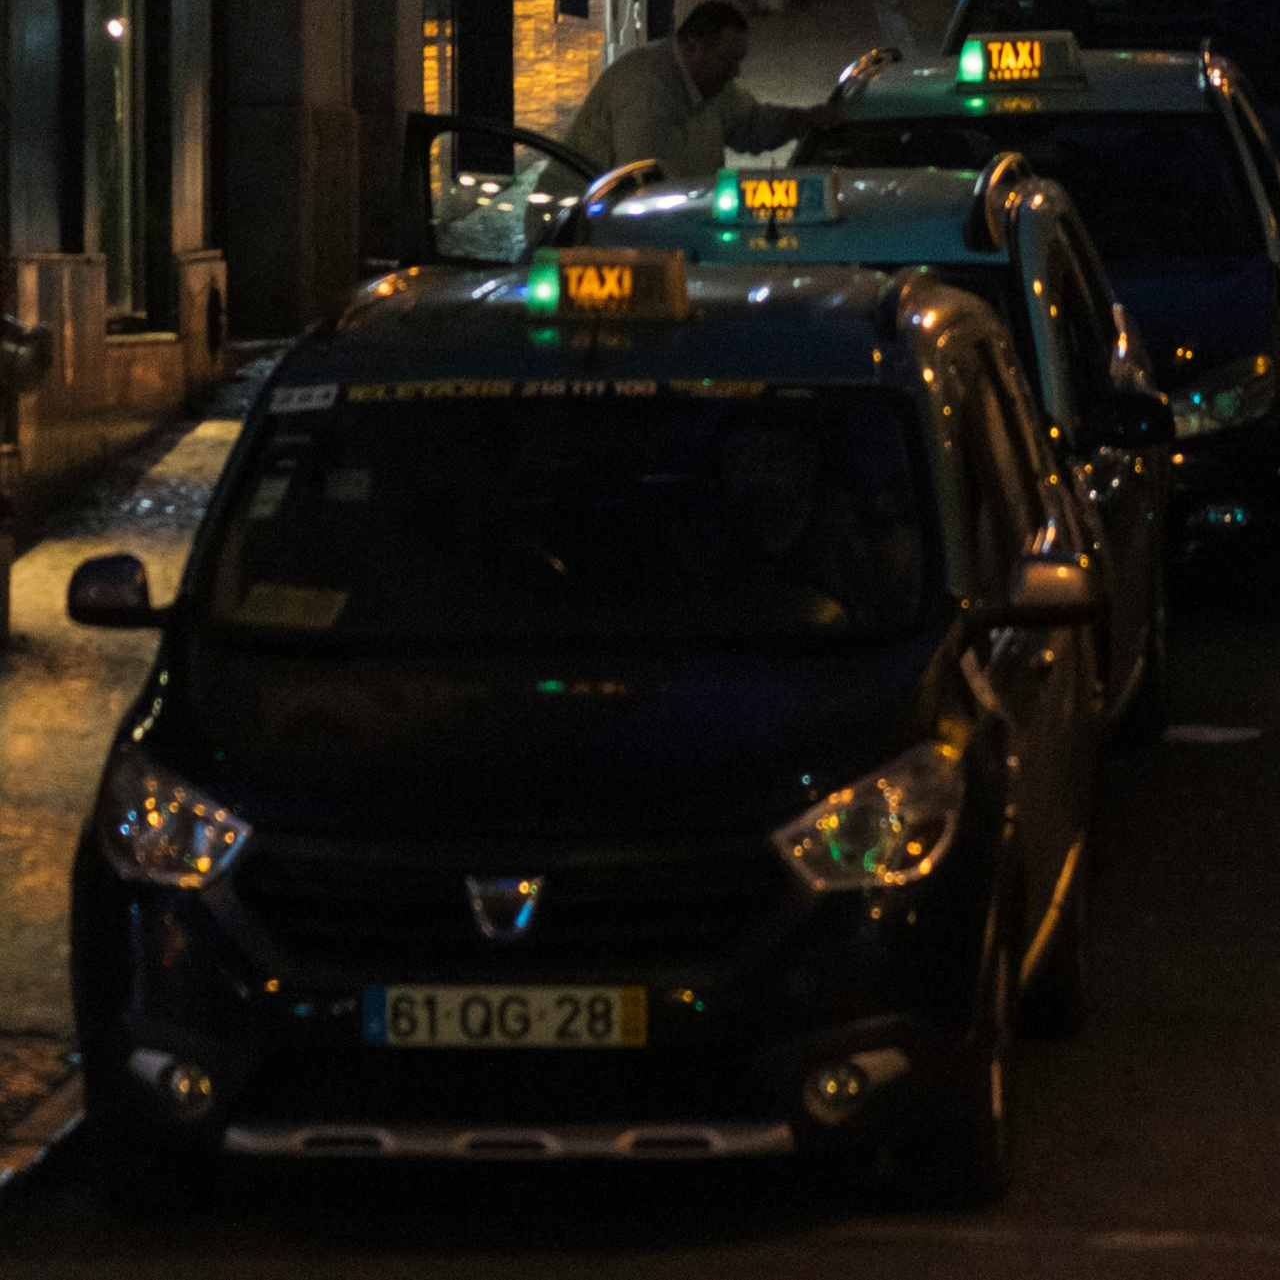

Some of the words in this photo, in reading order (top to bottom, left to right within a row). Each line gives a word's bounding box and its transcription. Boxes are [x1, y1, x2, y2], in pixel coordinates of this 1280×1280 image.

[987, 40, 1042, 69] TAXI
[741, 179, 799, 208] TAXI
[565, 265, 633, 298] TAXI
